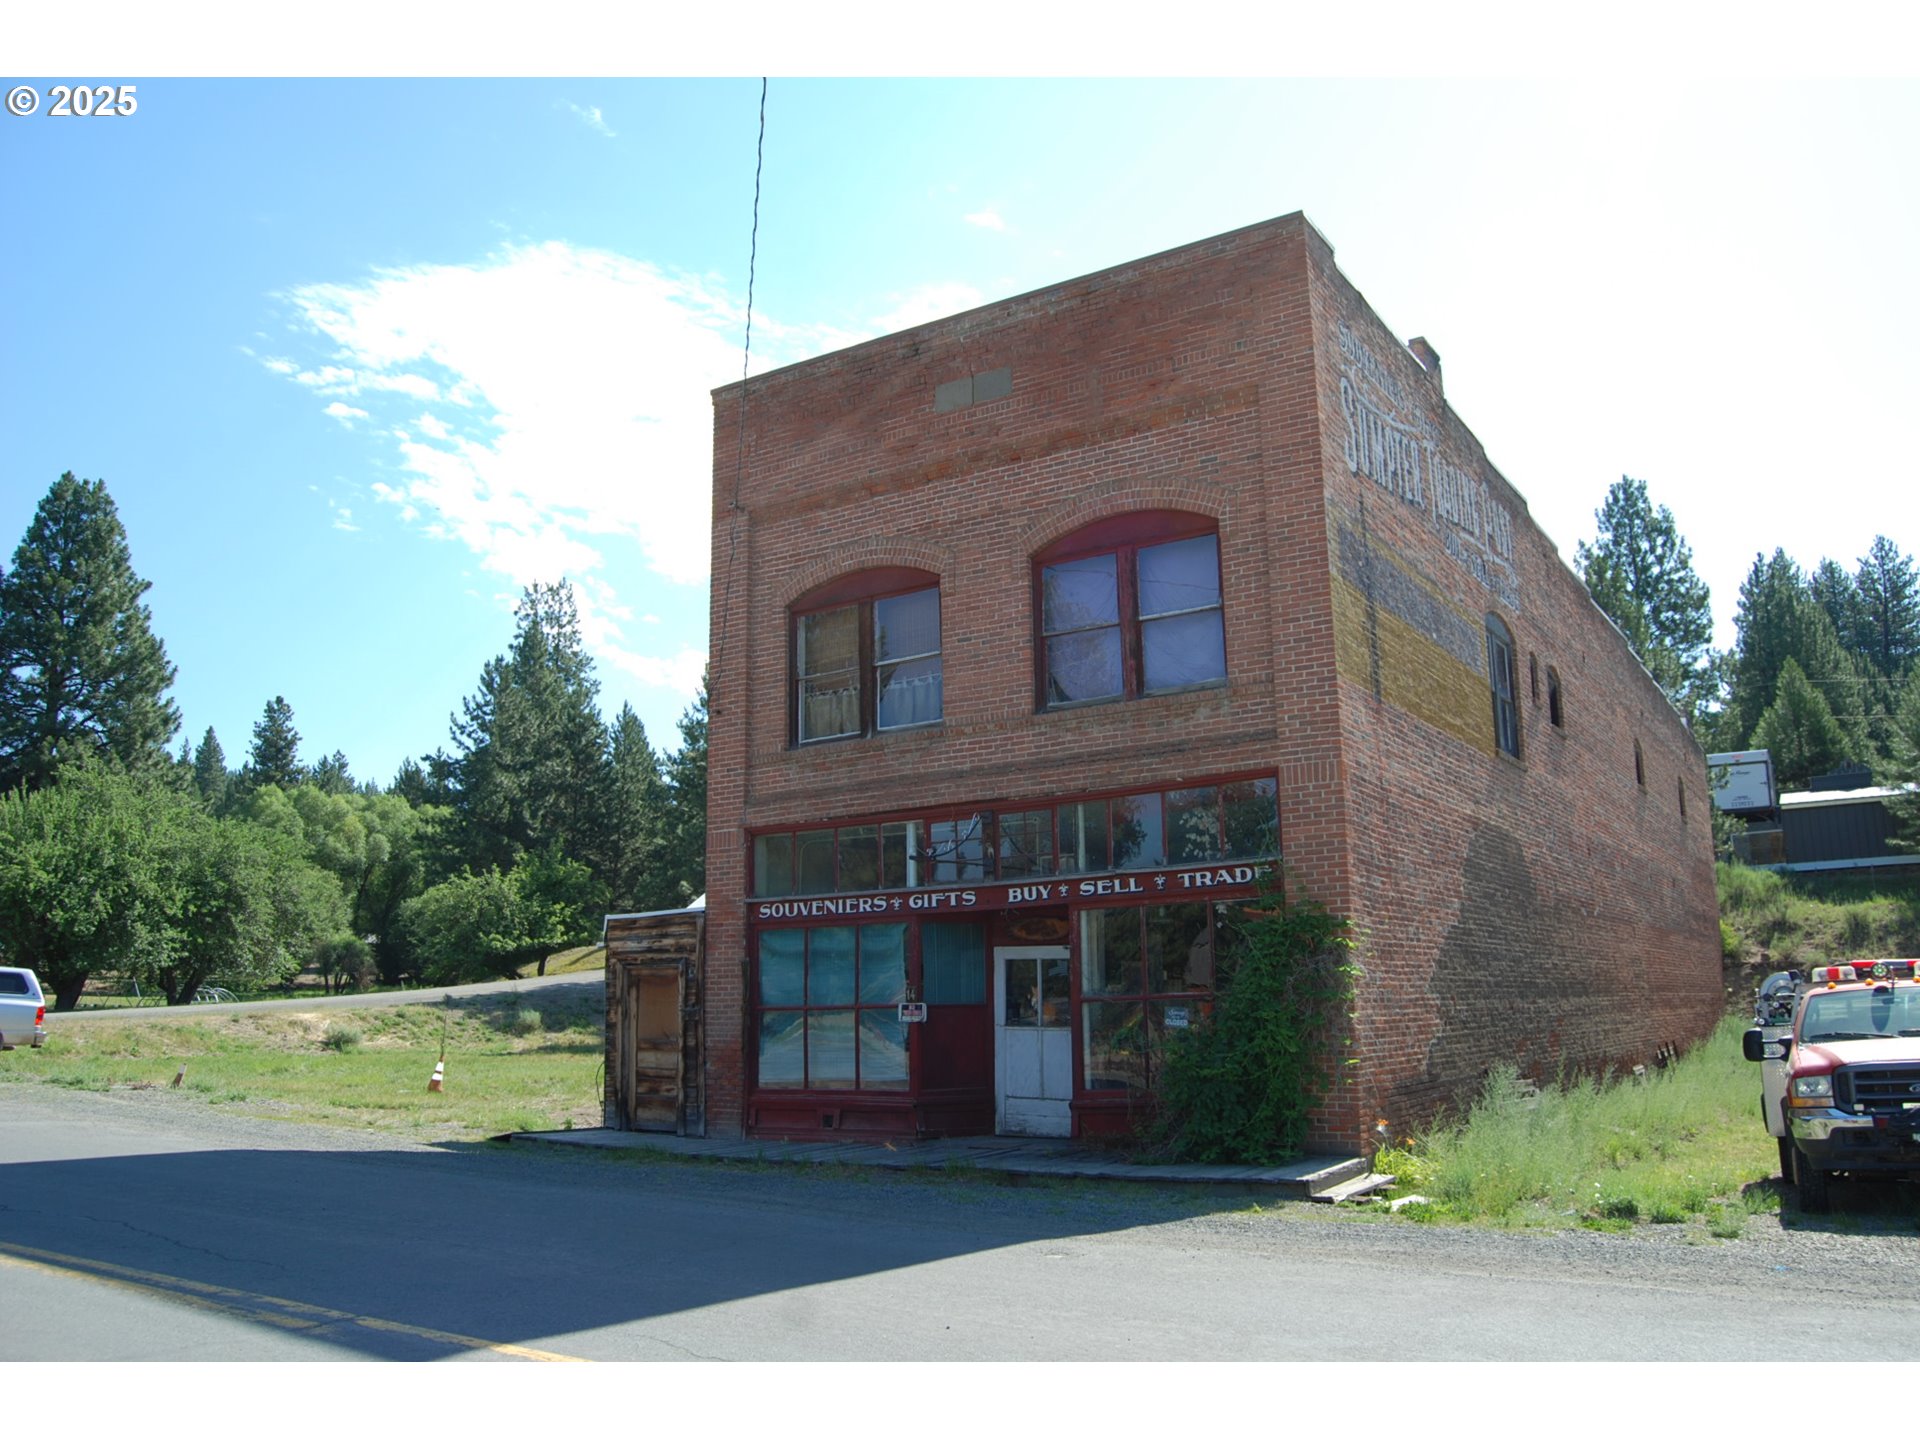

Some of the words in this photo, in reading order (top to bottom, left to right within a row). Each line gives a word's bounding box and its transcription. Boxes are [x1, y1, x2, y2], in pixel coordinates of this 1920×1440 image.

[1340, 377, 1426, 511] SUMPTER
[1480, 480, 1513, 563] POST
[759, 896, 888, 919] SOUVENIERS
[909, 890, 976, 909] GIFTS
[1008, 885, 1052, 903] BUY
[1079, 877, 1144, 897] SELL
